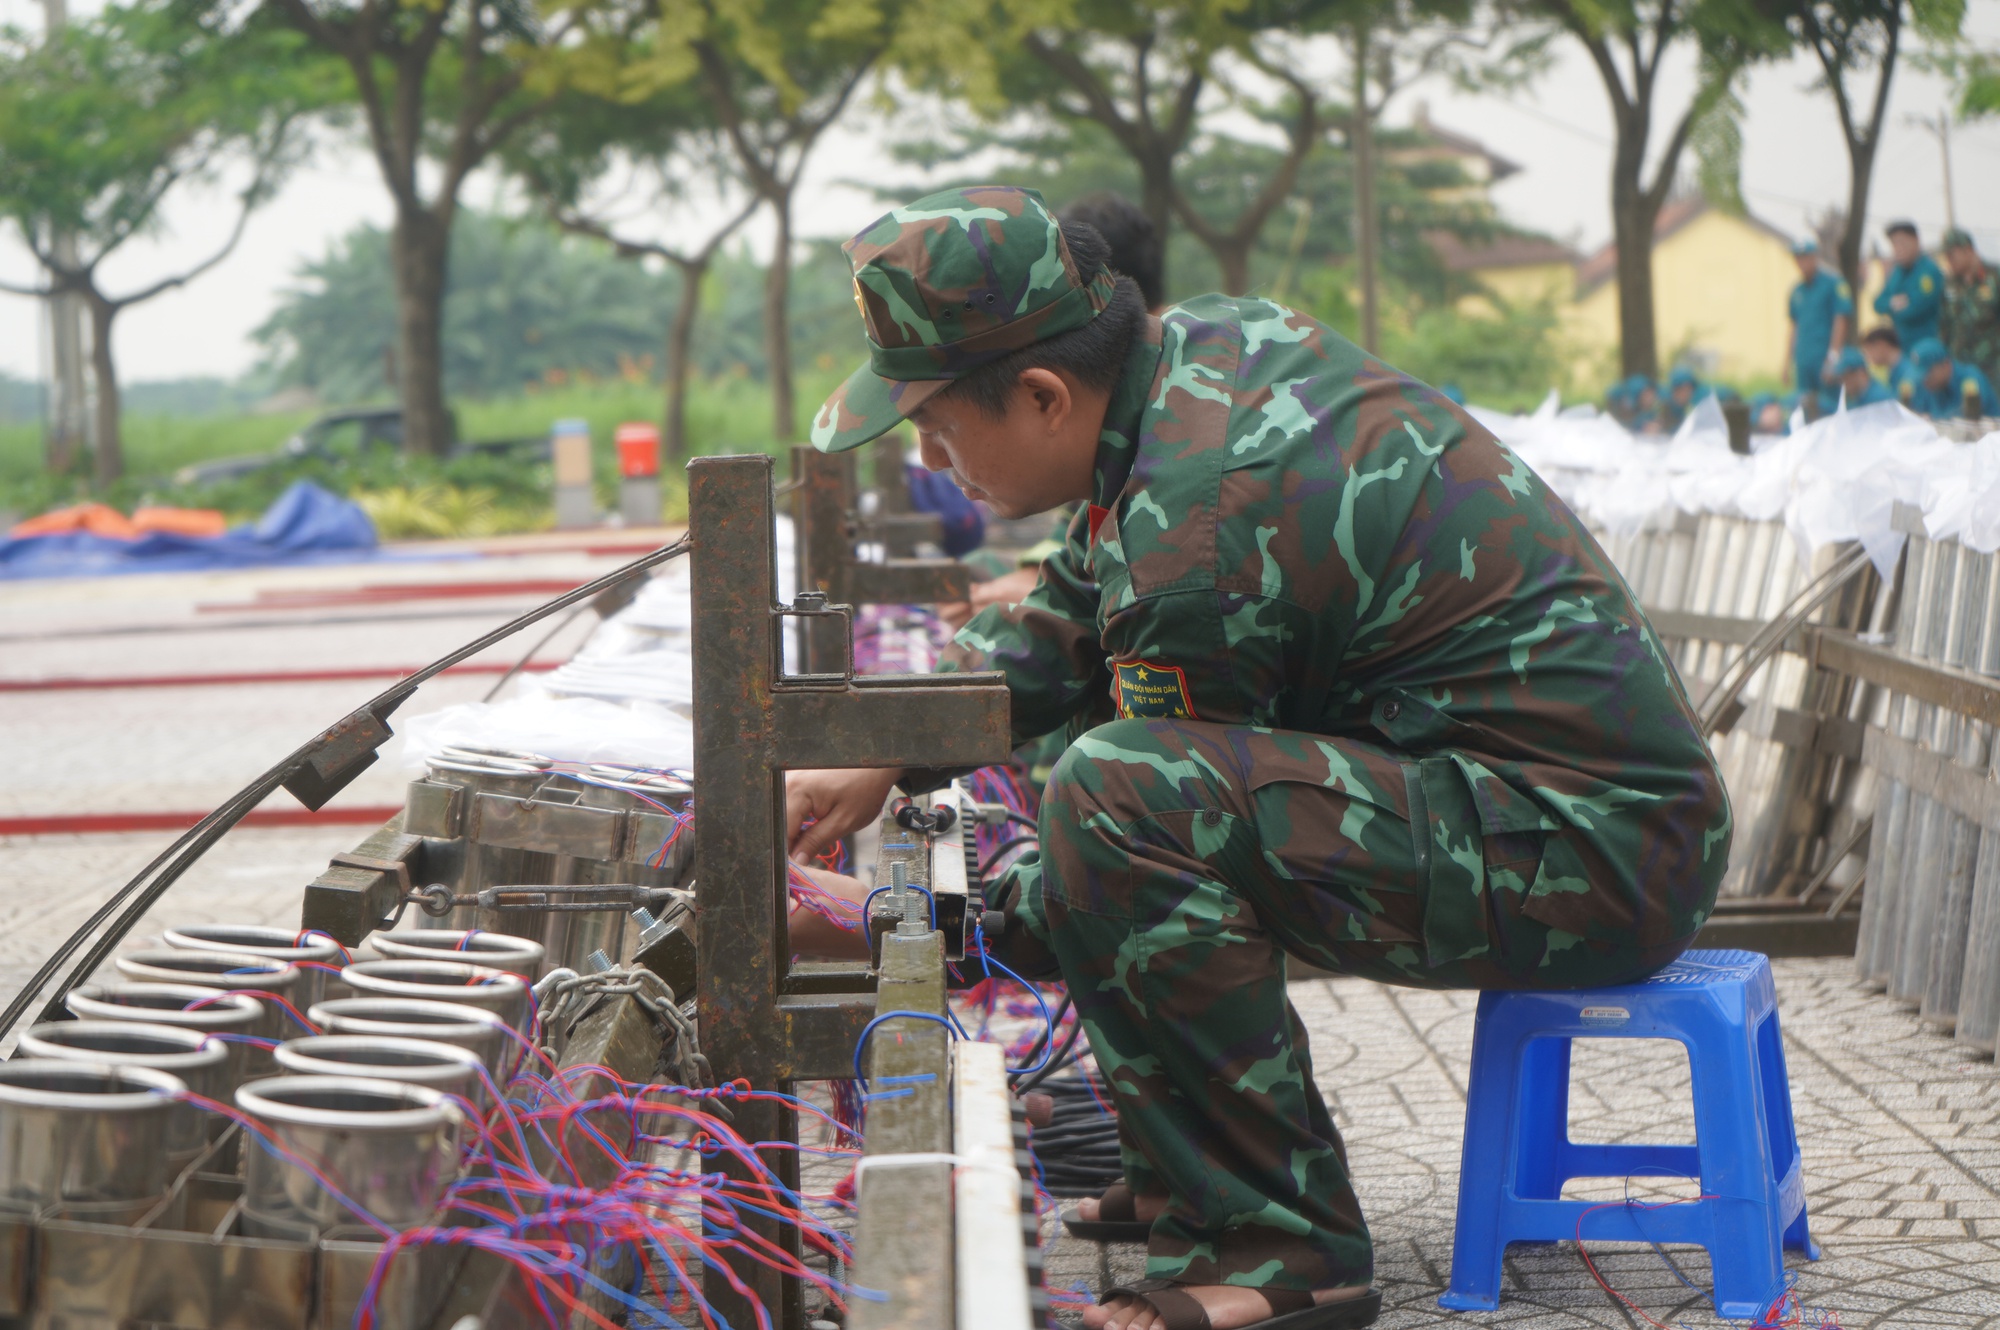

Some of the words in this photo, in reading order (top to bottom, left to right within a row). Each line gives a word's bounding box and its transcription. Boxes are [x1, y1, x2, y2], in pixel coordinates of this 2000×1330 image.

[1121, 679, 1134, 691] QUÂN
[1145, 685, 1162, 693] NHÂN
[1163, 685, 1177, 693] DÂN
[1133, 695, 1147, 704] VIỆT
